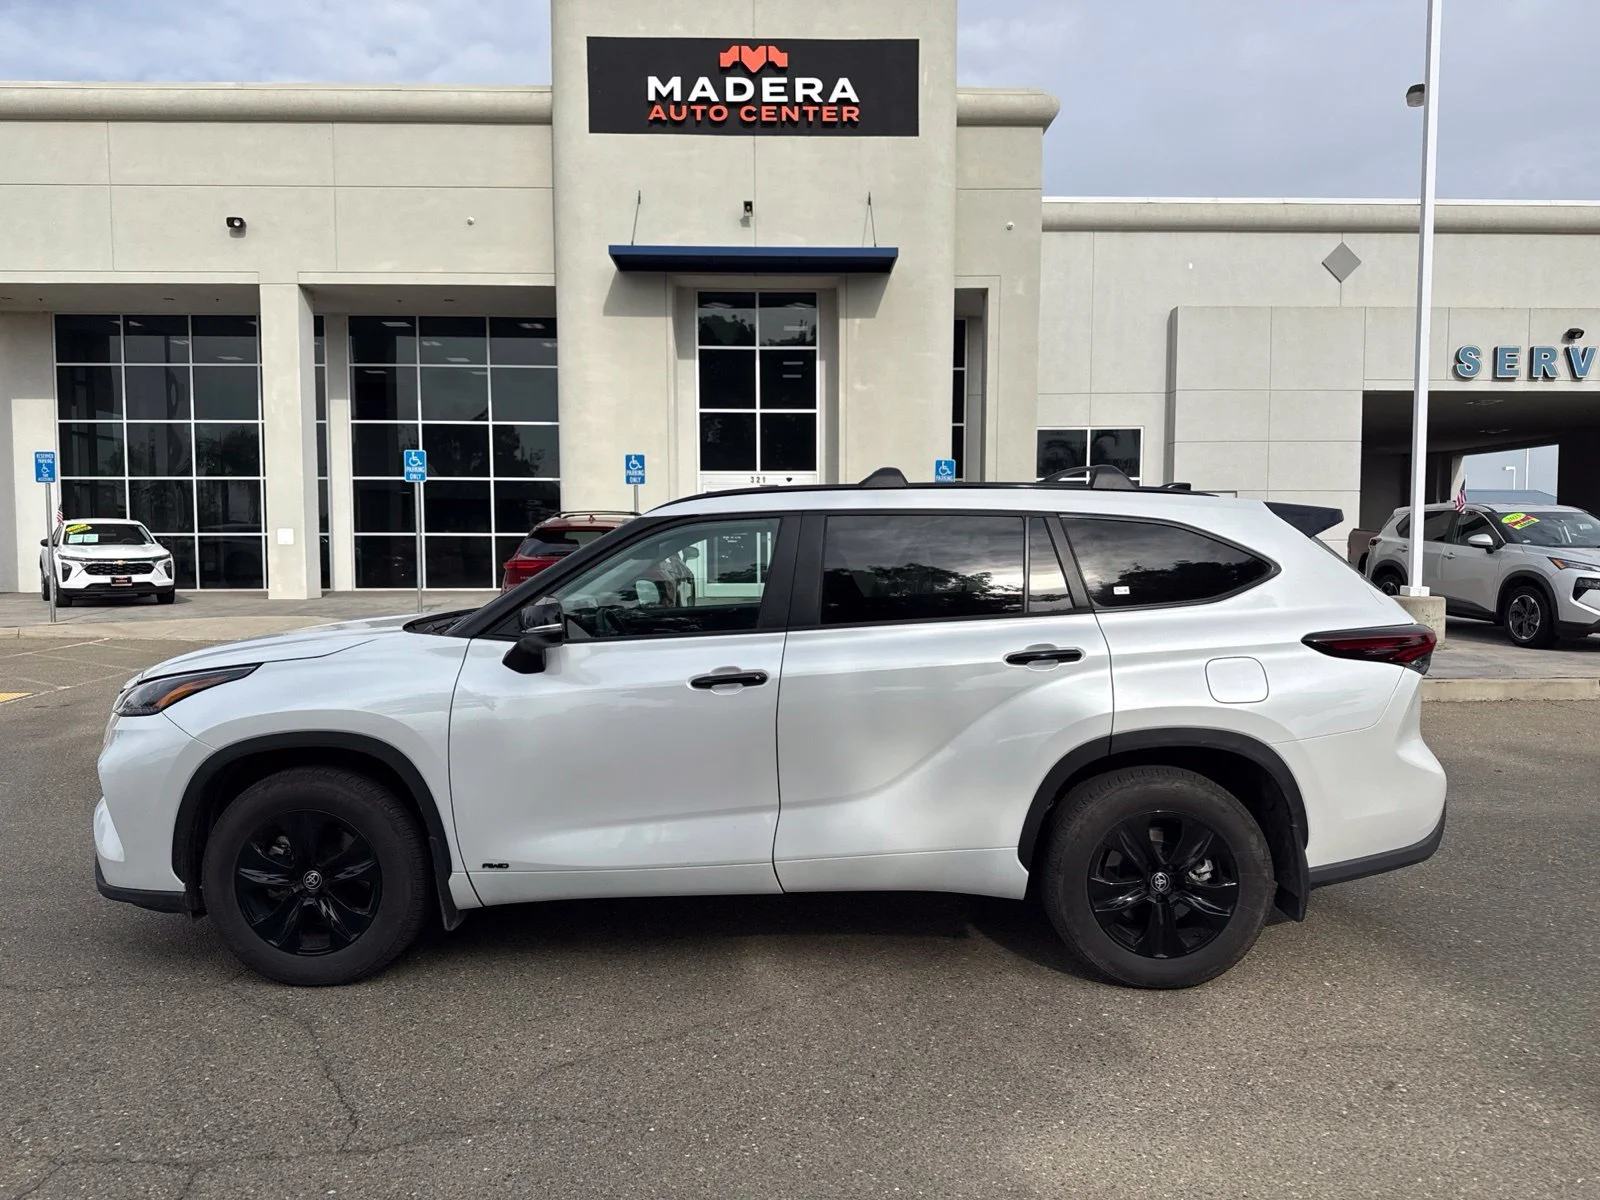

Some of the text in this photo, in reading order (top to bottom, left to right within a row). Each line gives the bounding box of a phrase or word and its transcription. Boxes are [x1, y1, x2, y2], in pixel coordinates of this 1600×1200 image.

[647, 76, 860, 103] MADERA
[648, 105, 860, 122] AUTO CENTER
[1455, 345, 1598, 379] SERV
